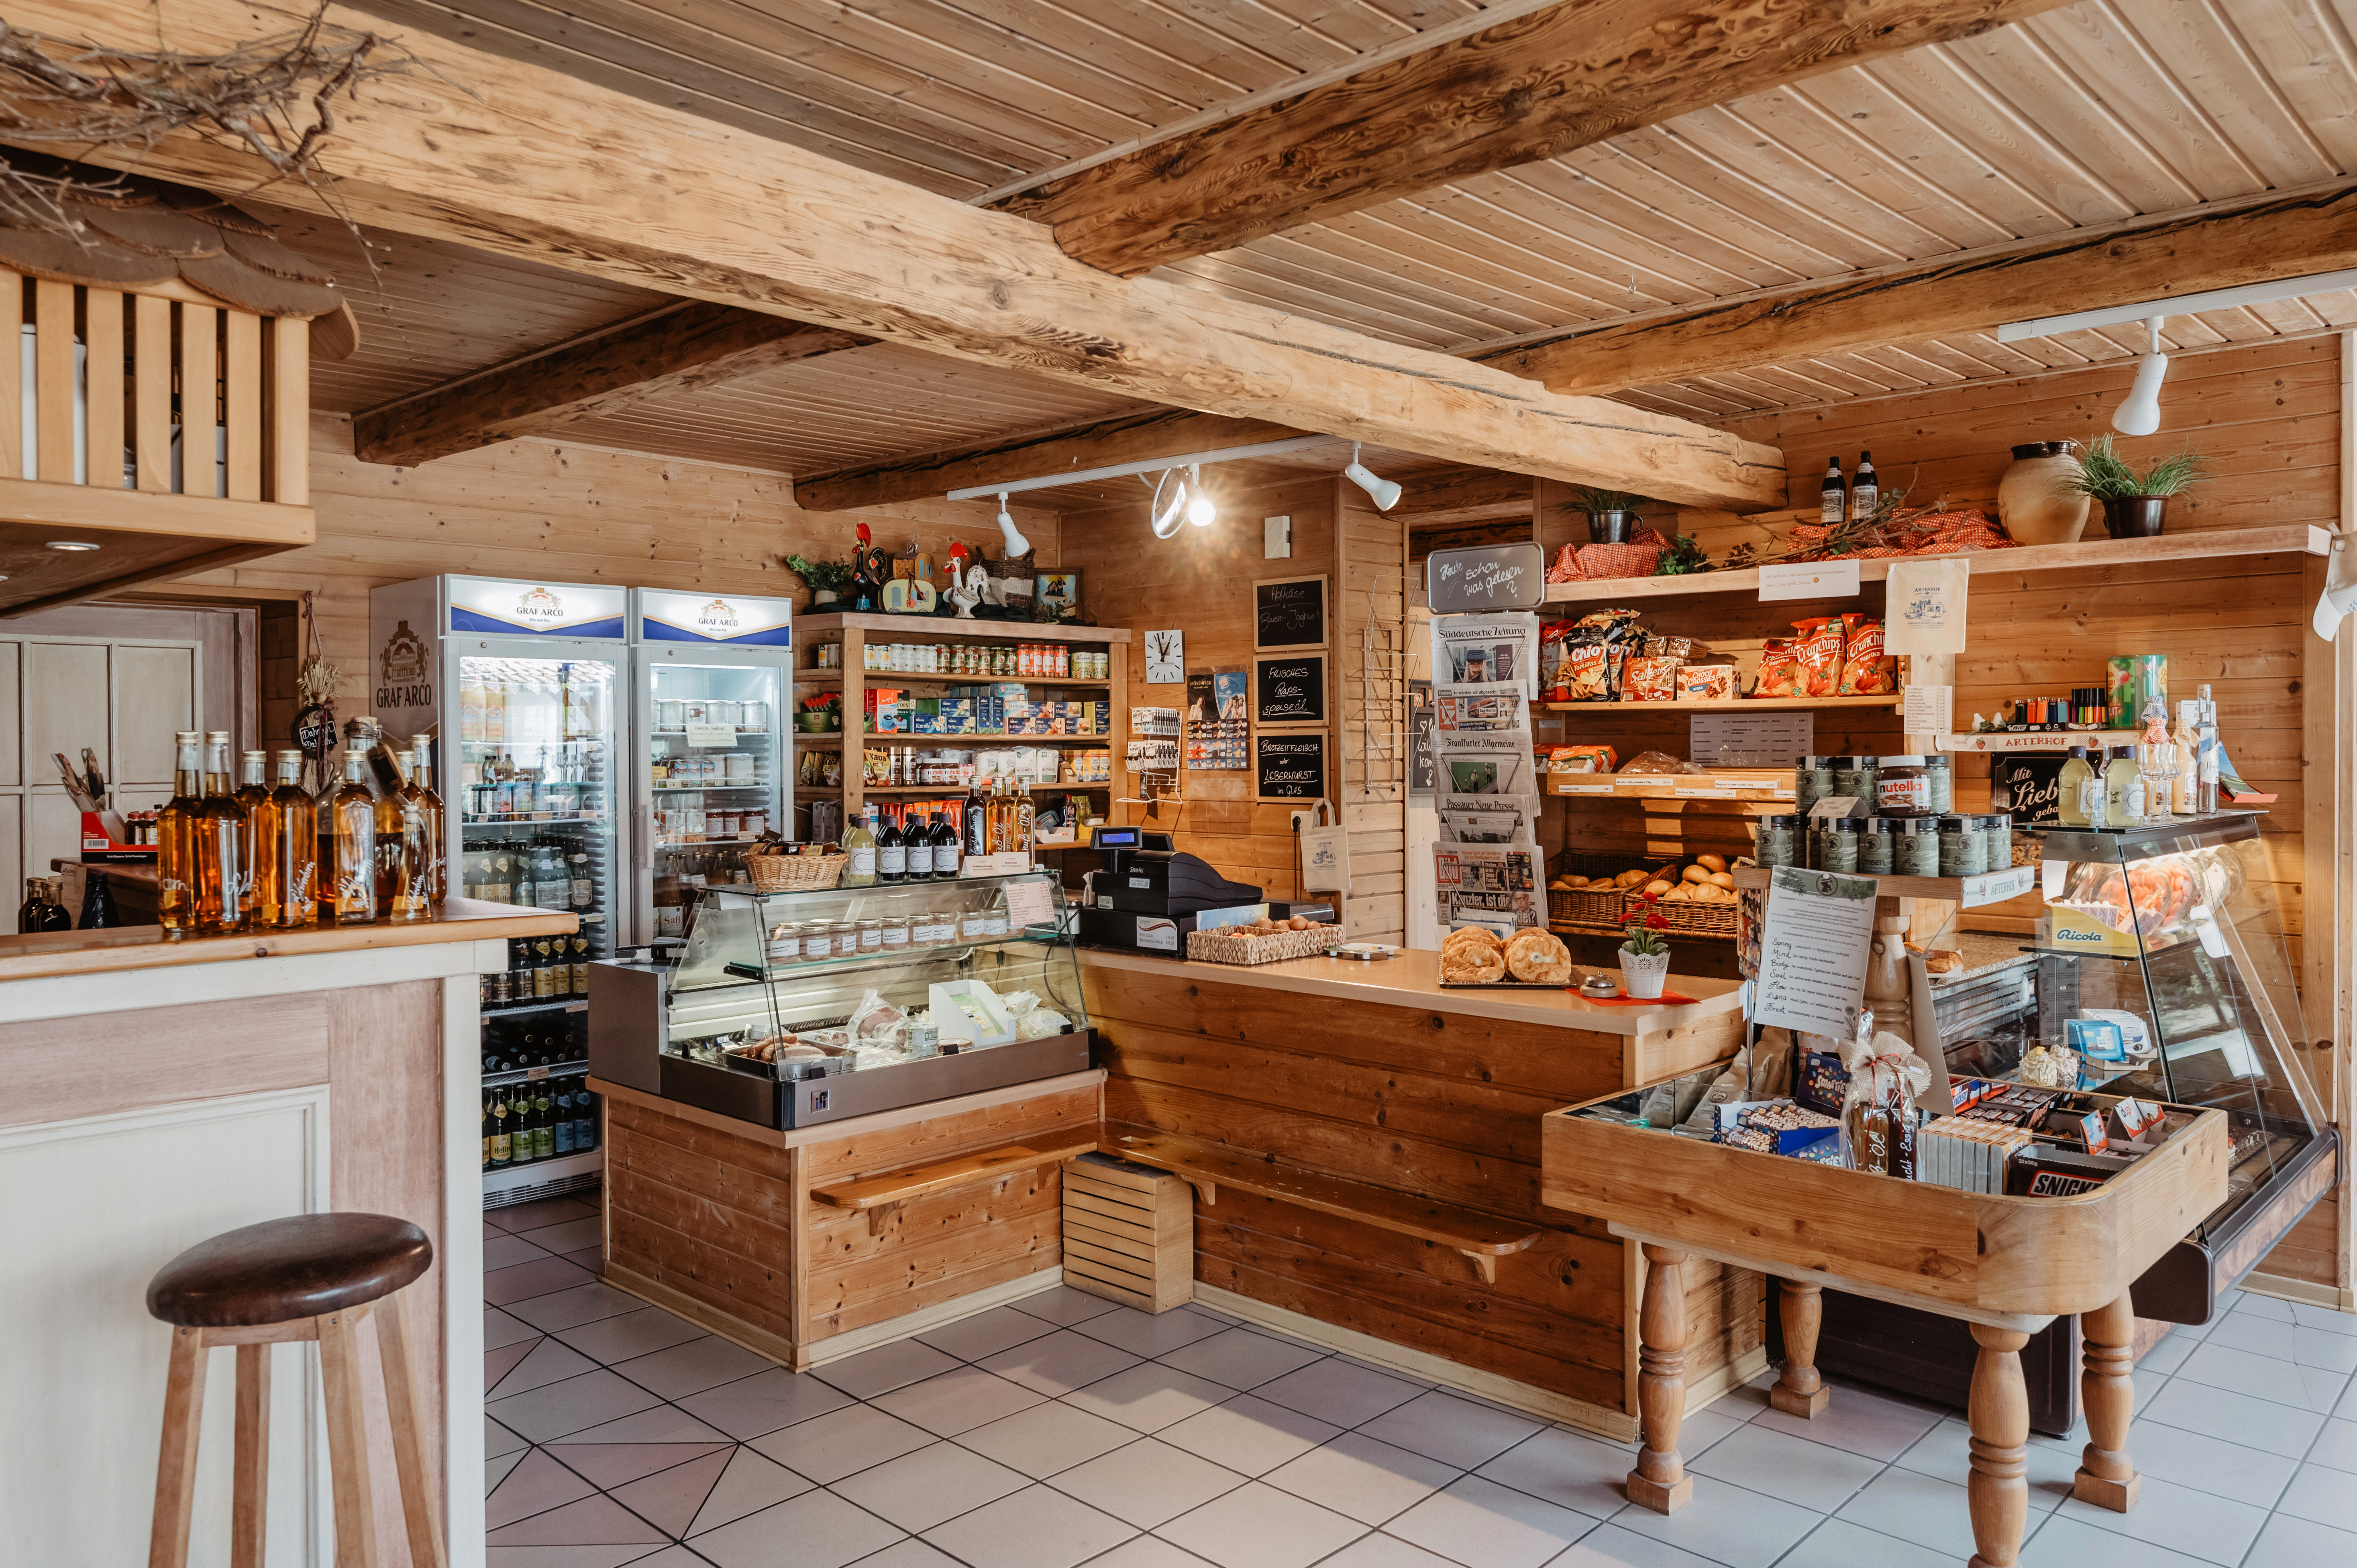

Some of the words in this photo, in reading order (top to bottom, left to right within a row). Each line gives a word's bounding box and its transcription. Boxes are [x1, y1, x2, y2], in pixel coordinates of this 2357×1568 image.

[1466, 561, 1500, 580] schon
[1464, 580, 1483, 597] was
[1486, 565, 1524, 598] gelesen
[1271, 586, 1305, 602] Hofkäse
[1507, 580, 1518, 599] ?
[517, 607, 539, 615] GRAF
[540, 608, 563, 617] ARCO
[719, 619, 738, 627] ARCO
[1260, 612, 1287, 632] Bauern-
[1287, 609, 1320, 630] Joghurt
[1439, 629, 1492, 638] Süddeutsche
[1492, 627, 1526, 637] Zeitung
[1571, 646, 1602, 662] Chio
[1796, 637, 1841, 664] Crunchips
[1769, 658, 1790, 667] Paprika
[1809, 656, 1830, 667] Paprika
[1860, 651, 1880, 663] Paprika
[1574, 660, 1597, 672] Tortillas
[1268, 668, 1308, 679] FRISCHES
[1692, 670, 1713, 679] CHOCO
[1688, 675, 1715, 687] CROSSIES
[1275, 682, 1302, 695] Raps-
[377, 686, 403, 708] GRAF
[404, 684, 432, 707] ARCO
[1262, 698, 1308, 715] speiseöl
[1260, 739, 1320, 753] BROTZEITFLEISCH
[1446, 738, 1480, 749] Frankfurter
[1481, 738, 1515, 749] Allgemeine
[2005, 737, 2067, 747] ARTERHOF
[870, 753, 887, 762] Kaba
[1264, 769, 1316, 782] LEBERWURST
[2006, 768, 2032, 783] Mit
[1277, 787, 1284, 795] im
[1286, 785, 1303, 797] GLAS
[1880, 781, 1923, 793] nutella
[1799, 791, 1819, 802] Fresh
[2008, 778, 2059, 812] Lieb
[1447, 799, 1474, 809] Passauer
[1475, 800, 1492, 809] Neue
[1494, 800, 1515, 810] Presse
[2033, 804, 2059, 822] geba
[1758, 850, 1778, 861] Spring
[1825, 853, 1845, 864] Body
[1861, 855, 1887, 866] Green
[1953, 856, 1978, 867] Berry
[1438, 857, 1459, 880] Bild
[1990, 880, 2016, 896] ARTERHOF
[1452, 892, 1485, 908] Kanzler,
[1486, 894, 1497, 907] ist
[1498, 894, 1512, 908] die
[2056, 929, 2103, 943] Ricola
[1772, 938, 1792, 950] Spring
[1771, 949, 1791, 959] Mind
[1771, 960, 1790, 970] Body
[1770, 969, 1786, 979] Soul
[1764, 1003, 1786, 1014] Forest
[1800, 1046, 1813, 1055] Flips
[1953, 1088, 1968, 1109] SNICKERS
[2018, 1159, 2038, 1167] 32x50g
[2035, 1175, 2105, 1196] SNICK
